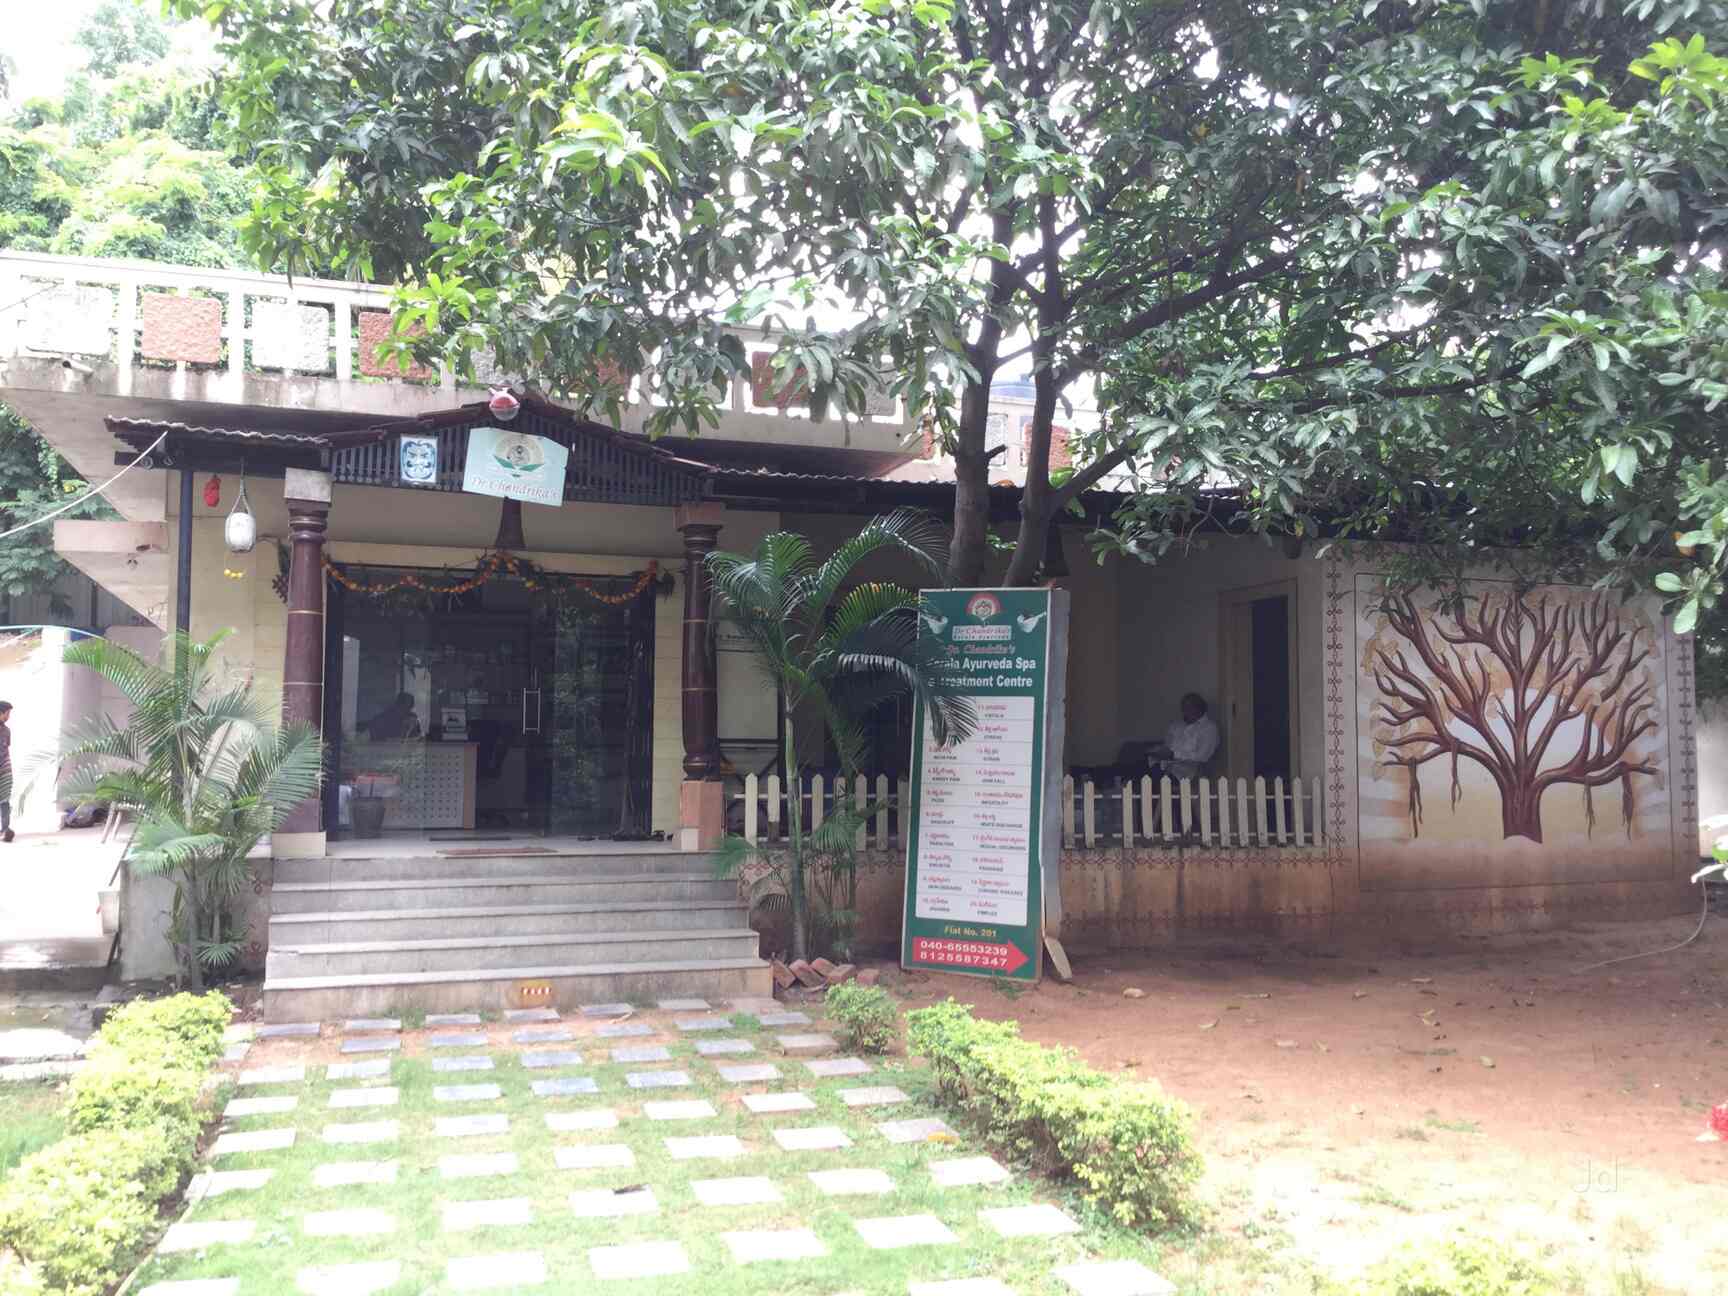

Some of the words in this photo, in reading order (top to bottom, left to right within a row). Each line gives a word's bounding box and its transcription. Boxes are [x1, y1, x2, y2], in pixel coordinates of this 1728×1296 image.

[962, 657, 1012, 672] Ayurveda
[1015, 658, 1036, 672] Spa
[996, 676, 1033, 688] Centre
[944, 926, 961, 935] Flat
[963, 927, 978, 937] No.
[980, 928, 997, 937] 201
